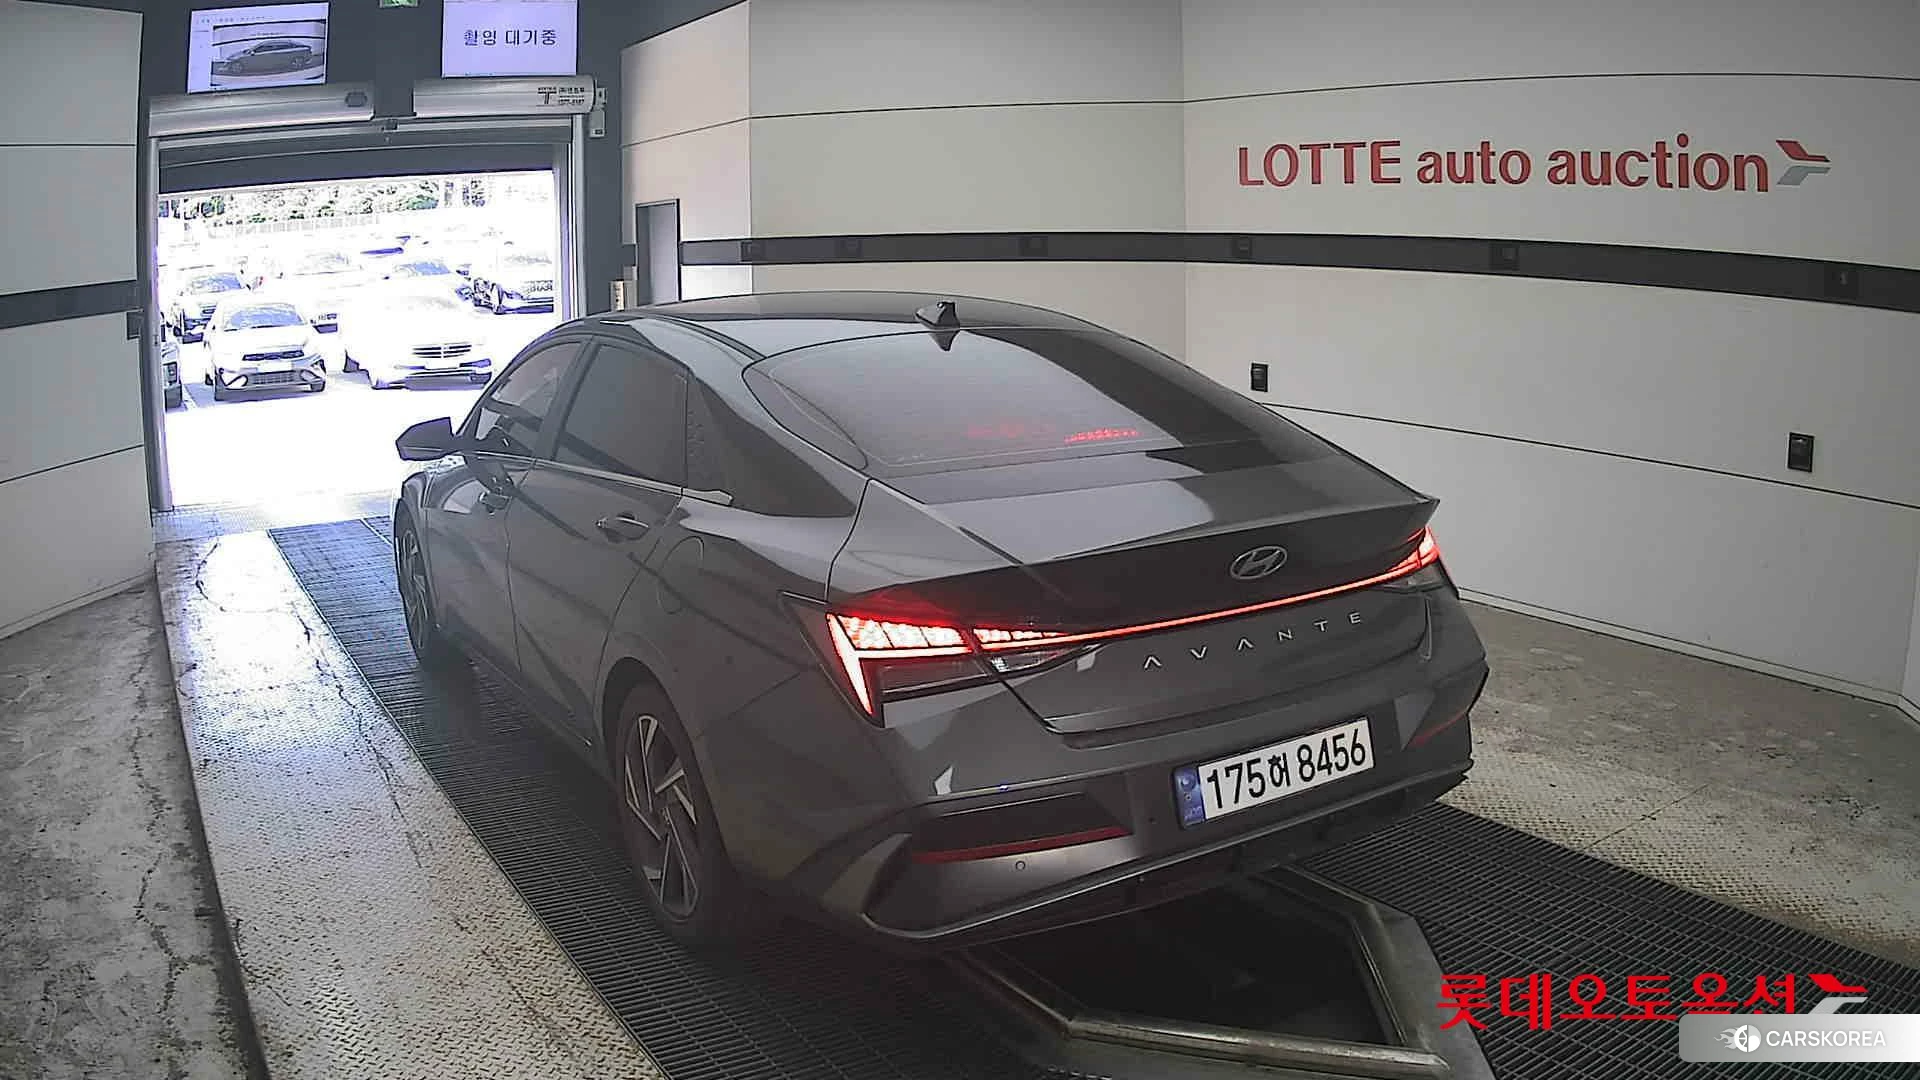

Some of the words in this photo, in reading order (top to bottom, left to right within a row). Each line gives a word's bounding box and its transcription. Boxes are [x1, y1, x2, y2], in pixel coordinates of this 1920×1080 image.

[504, 29, 557, 46] 대기중
[1238, 140, 1401, 187] LOTTE
[1417, 140, 1532, 185] auto
[1547, 132, 1769, 193] auction
[1143, 611, 1362, 669] AVANTE
[1206, 752, 1291, 809] 175허
[1297, 728, 1367, 783] 8456
